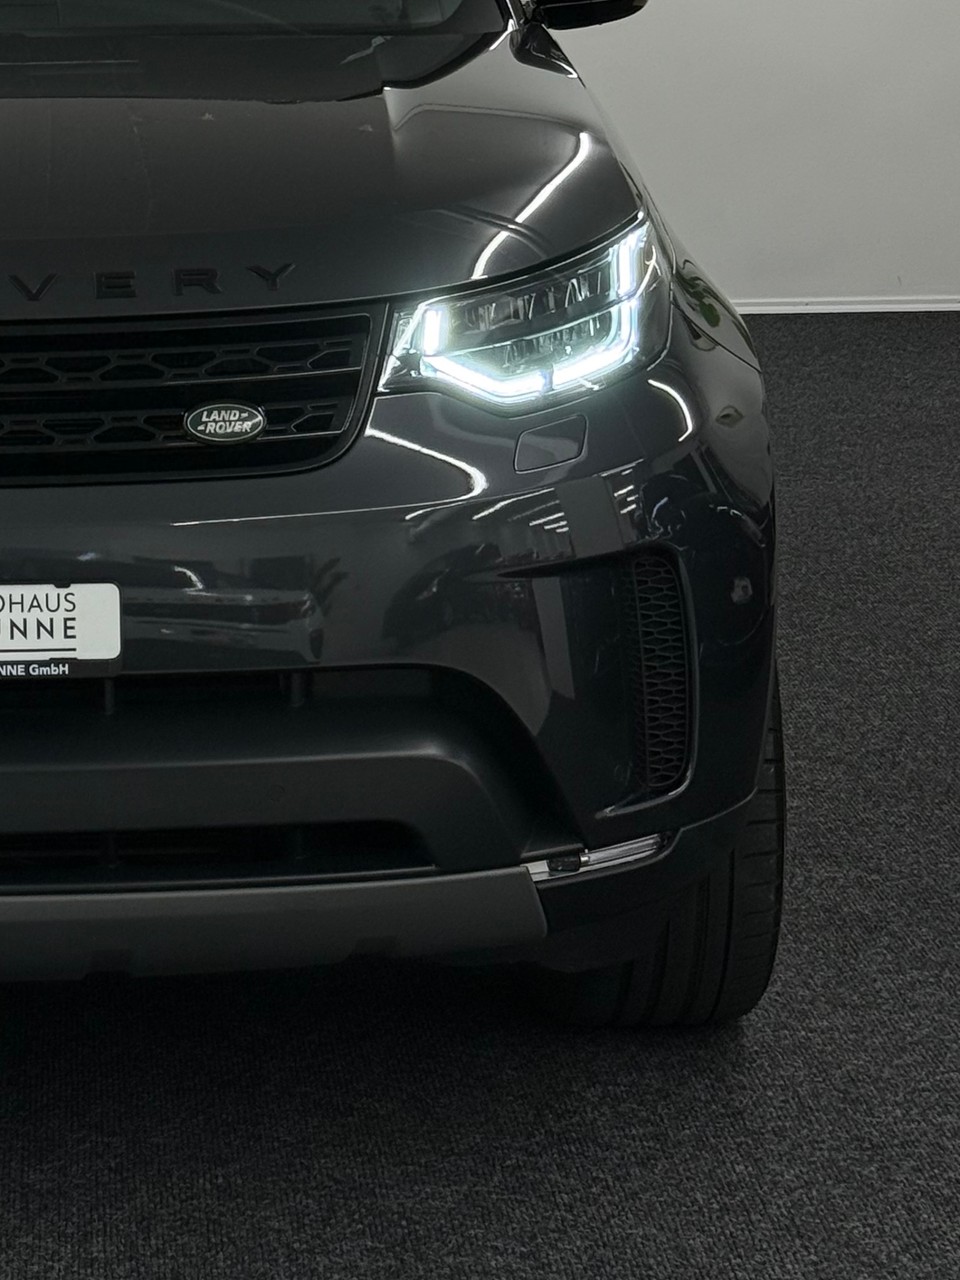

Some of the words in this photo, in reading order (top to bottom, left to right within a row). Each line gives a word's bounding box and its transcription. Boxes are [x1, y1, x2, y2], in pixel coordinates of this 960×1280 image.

[201, 410, 240, 422] LAND
[205, 421, 251, 434] ROVER
[29, 663, 69, 676] GmbH
